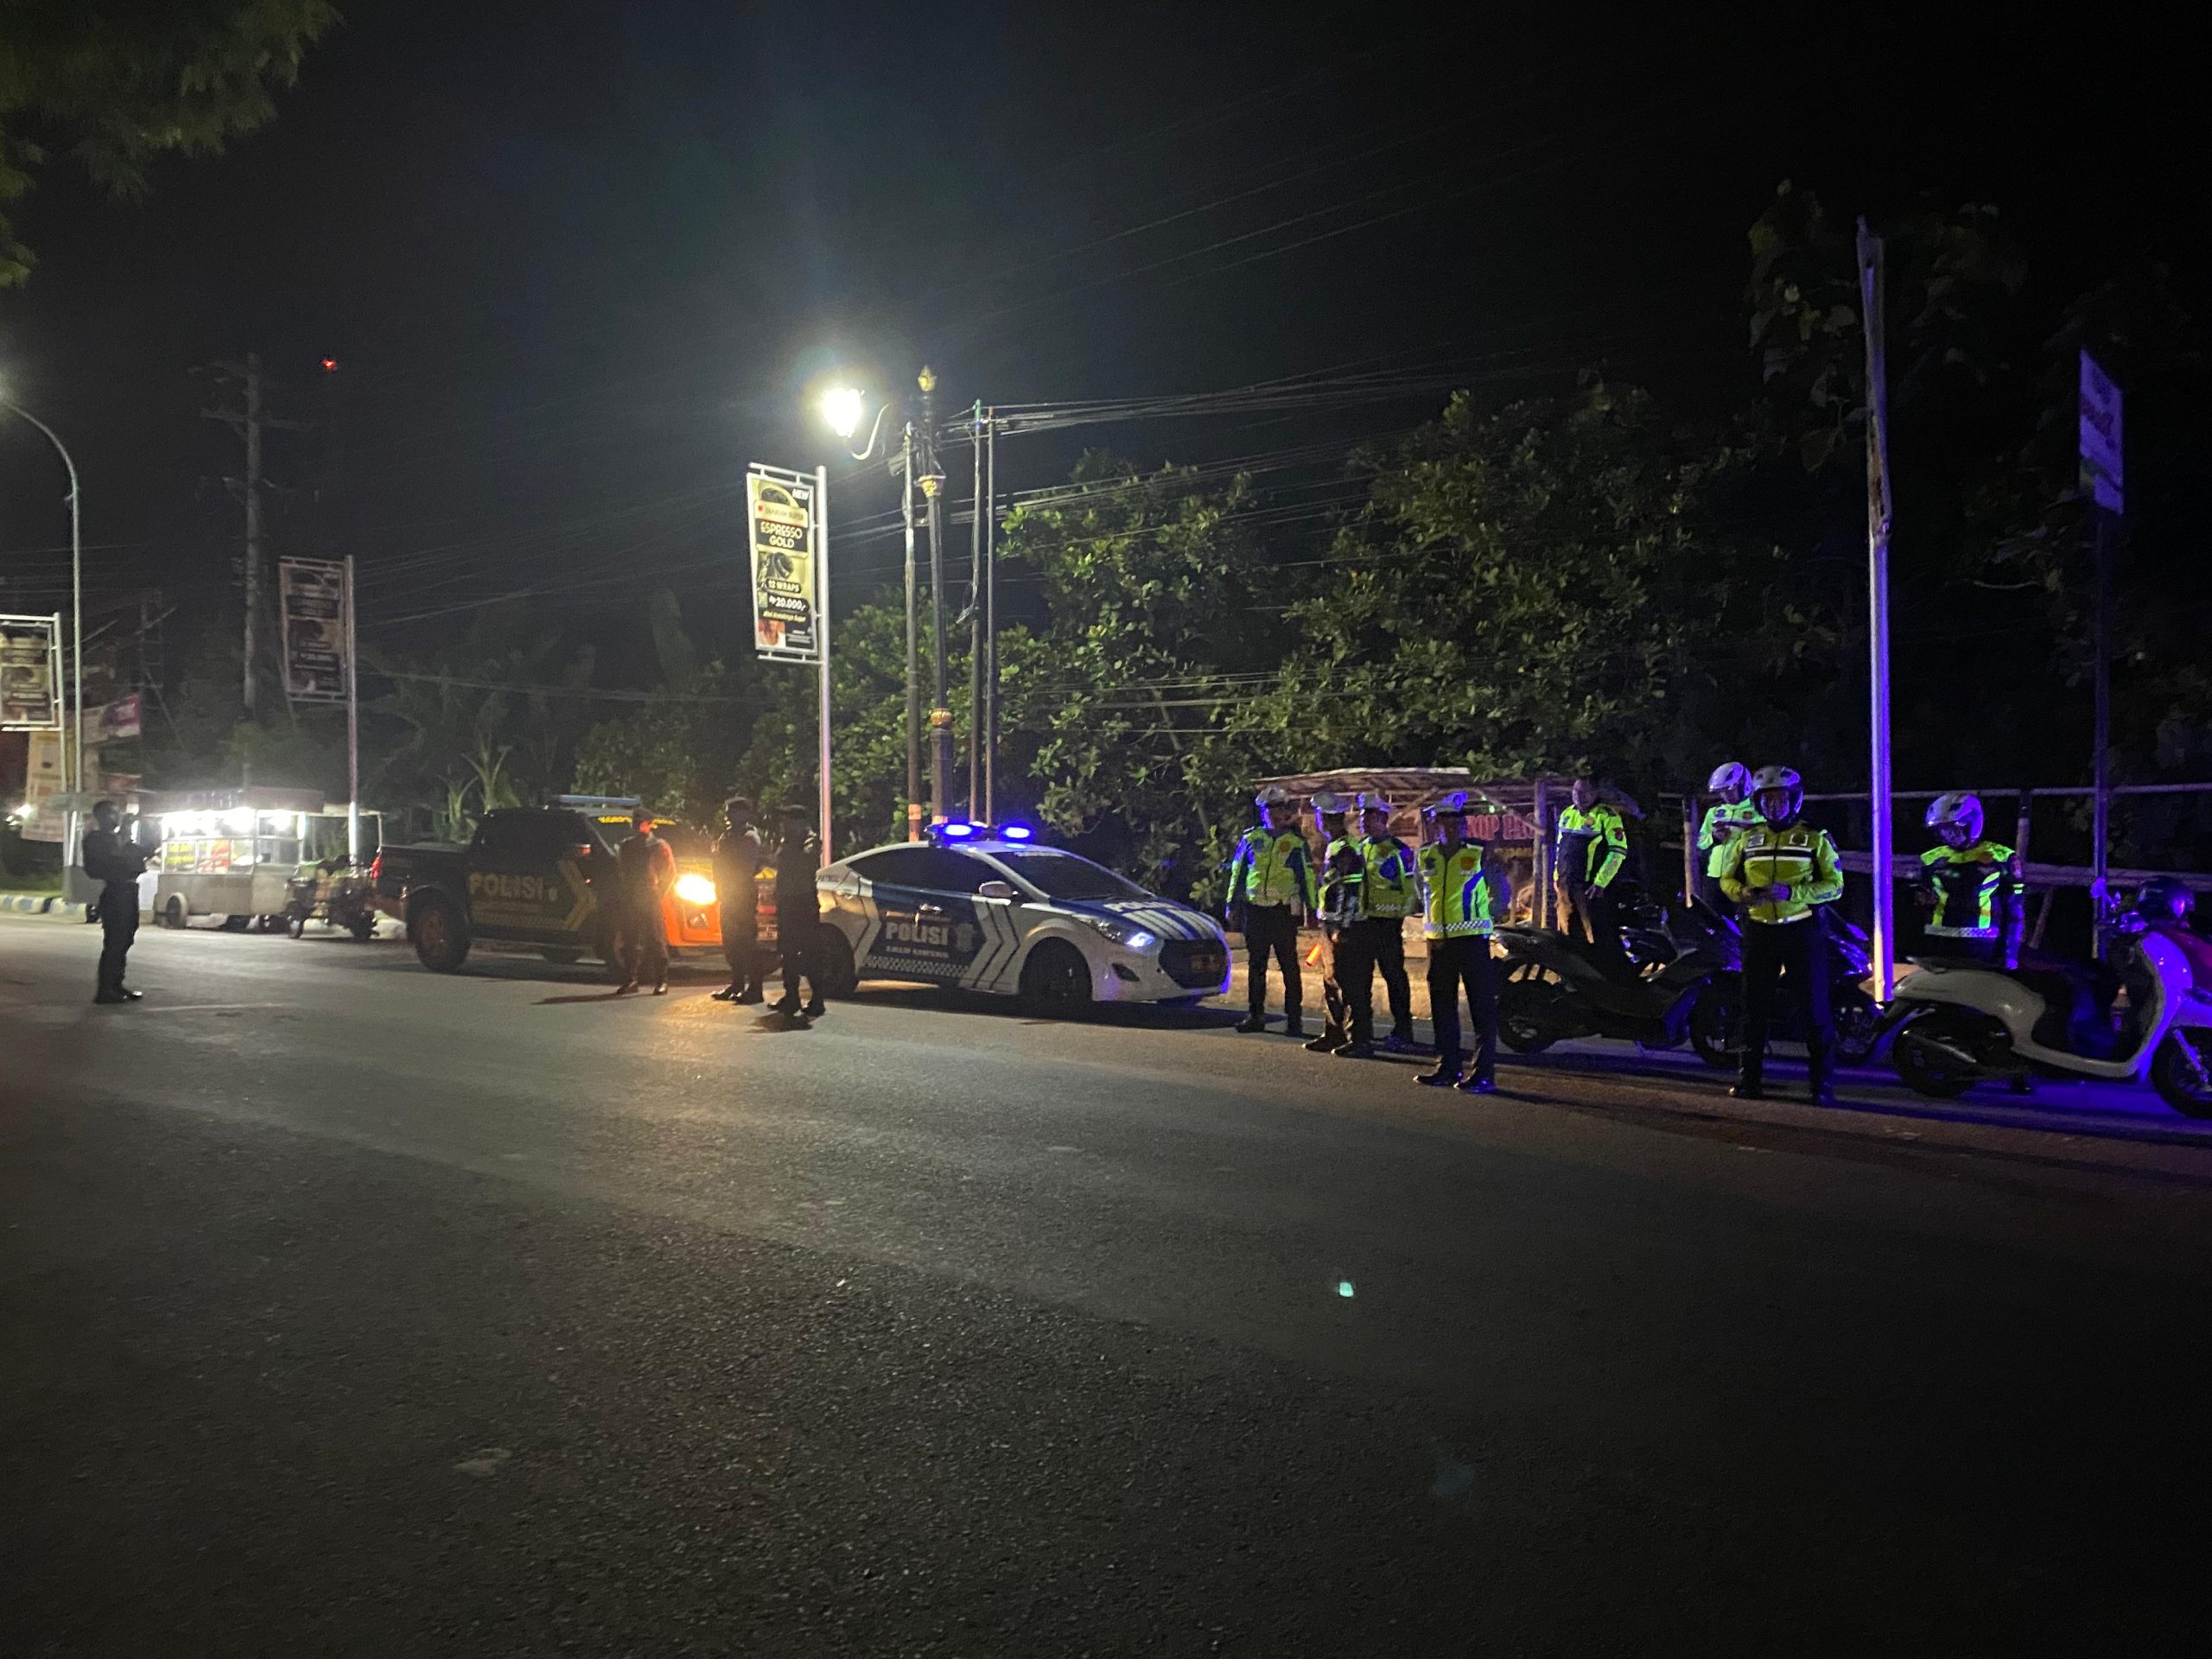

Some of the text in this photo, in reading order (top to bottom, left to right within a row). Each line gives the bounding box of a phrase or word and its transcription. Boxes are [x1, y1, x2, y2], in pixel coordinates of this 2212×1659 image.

[792, 488, 810, 500] NEW
[760, 521, 803, 540] ESPRESSO
[769, 535, 794, 549] GOLD
[768, 580, 800, 593] 12 WRAPS
[469, 872, 544, 900] POLISI
[886, 921, 950, 946] POLISI
